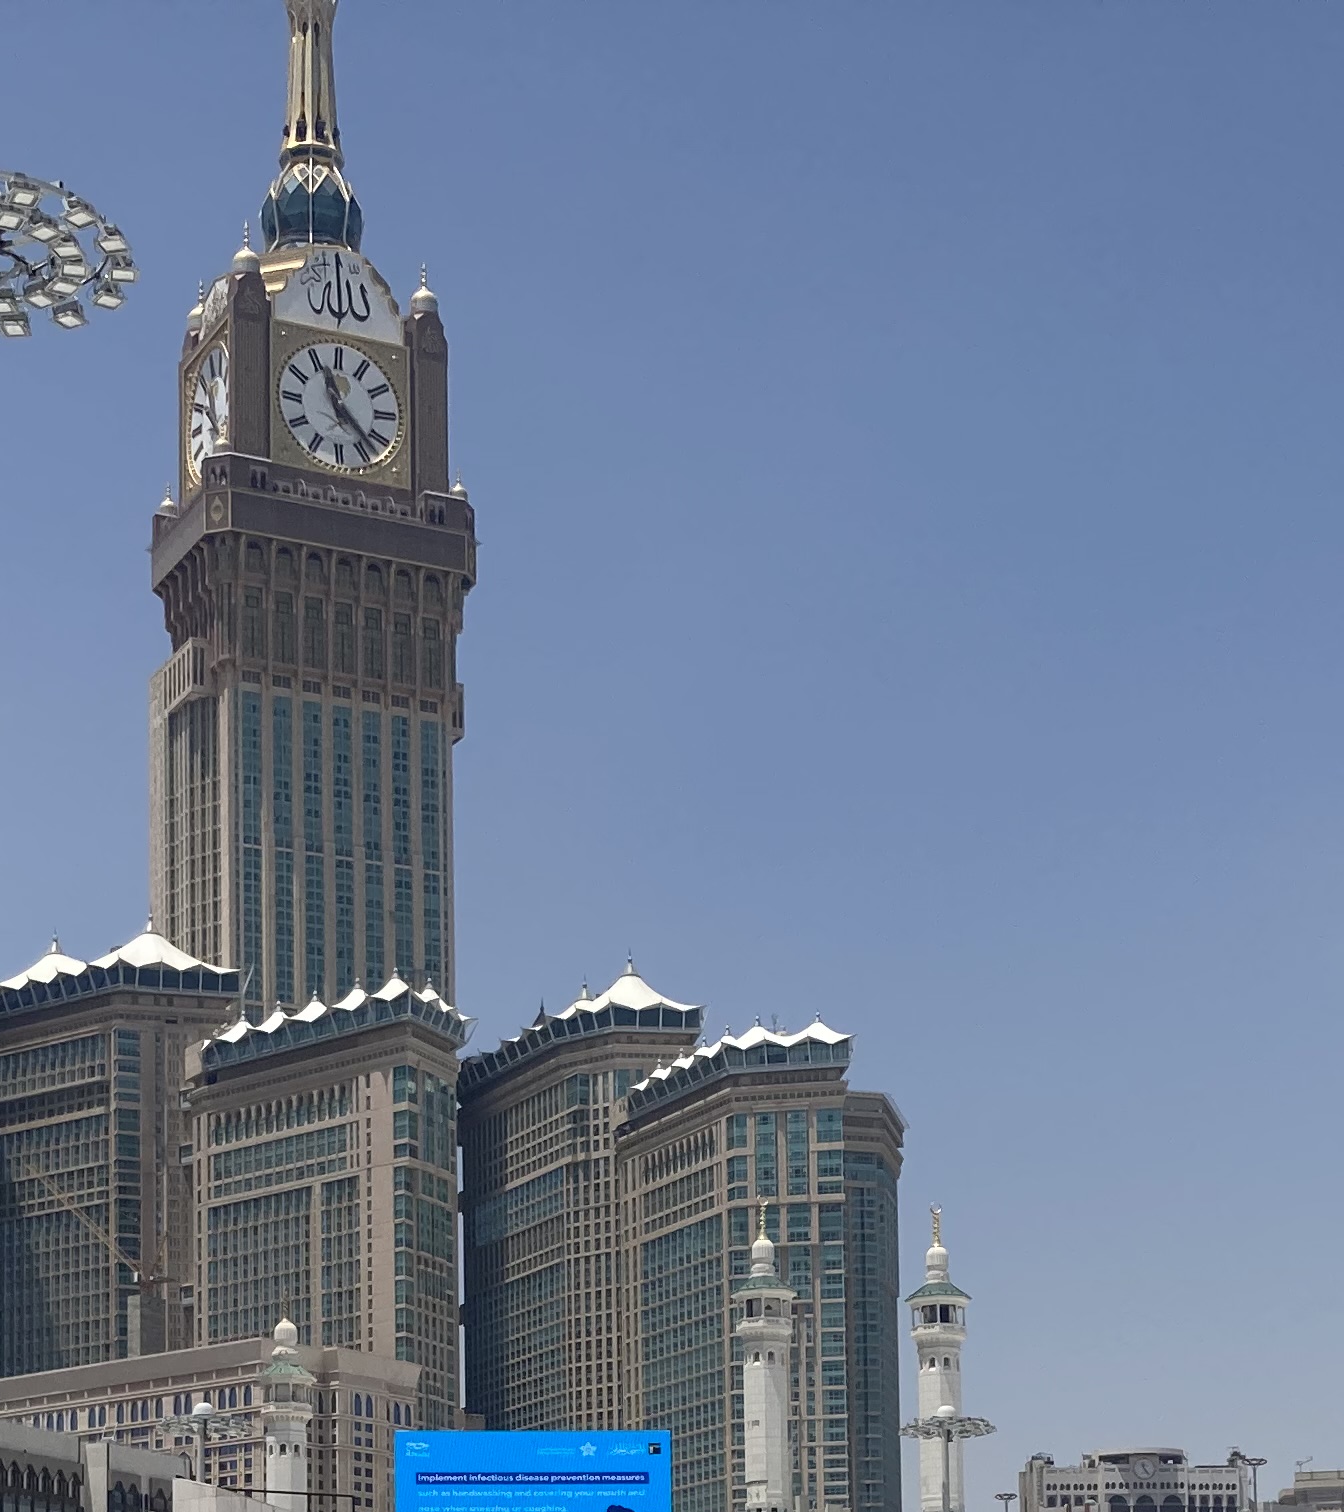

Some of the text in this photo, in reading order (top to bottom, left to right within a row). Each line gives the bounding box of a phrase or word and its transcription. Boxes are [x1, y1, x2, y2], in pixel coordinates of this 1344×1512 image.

[418, 1474, 467, 1482] Implement
[469, 1474, 513, 1482] infectious
[515, 1474, 549, 1482] disease
[551, 1474, 601, 1483] prevention
